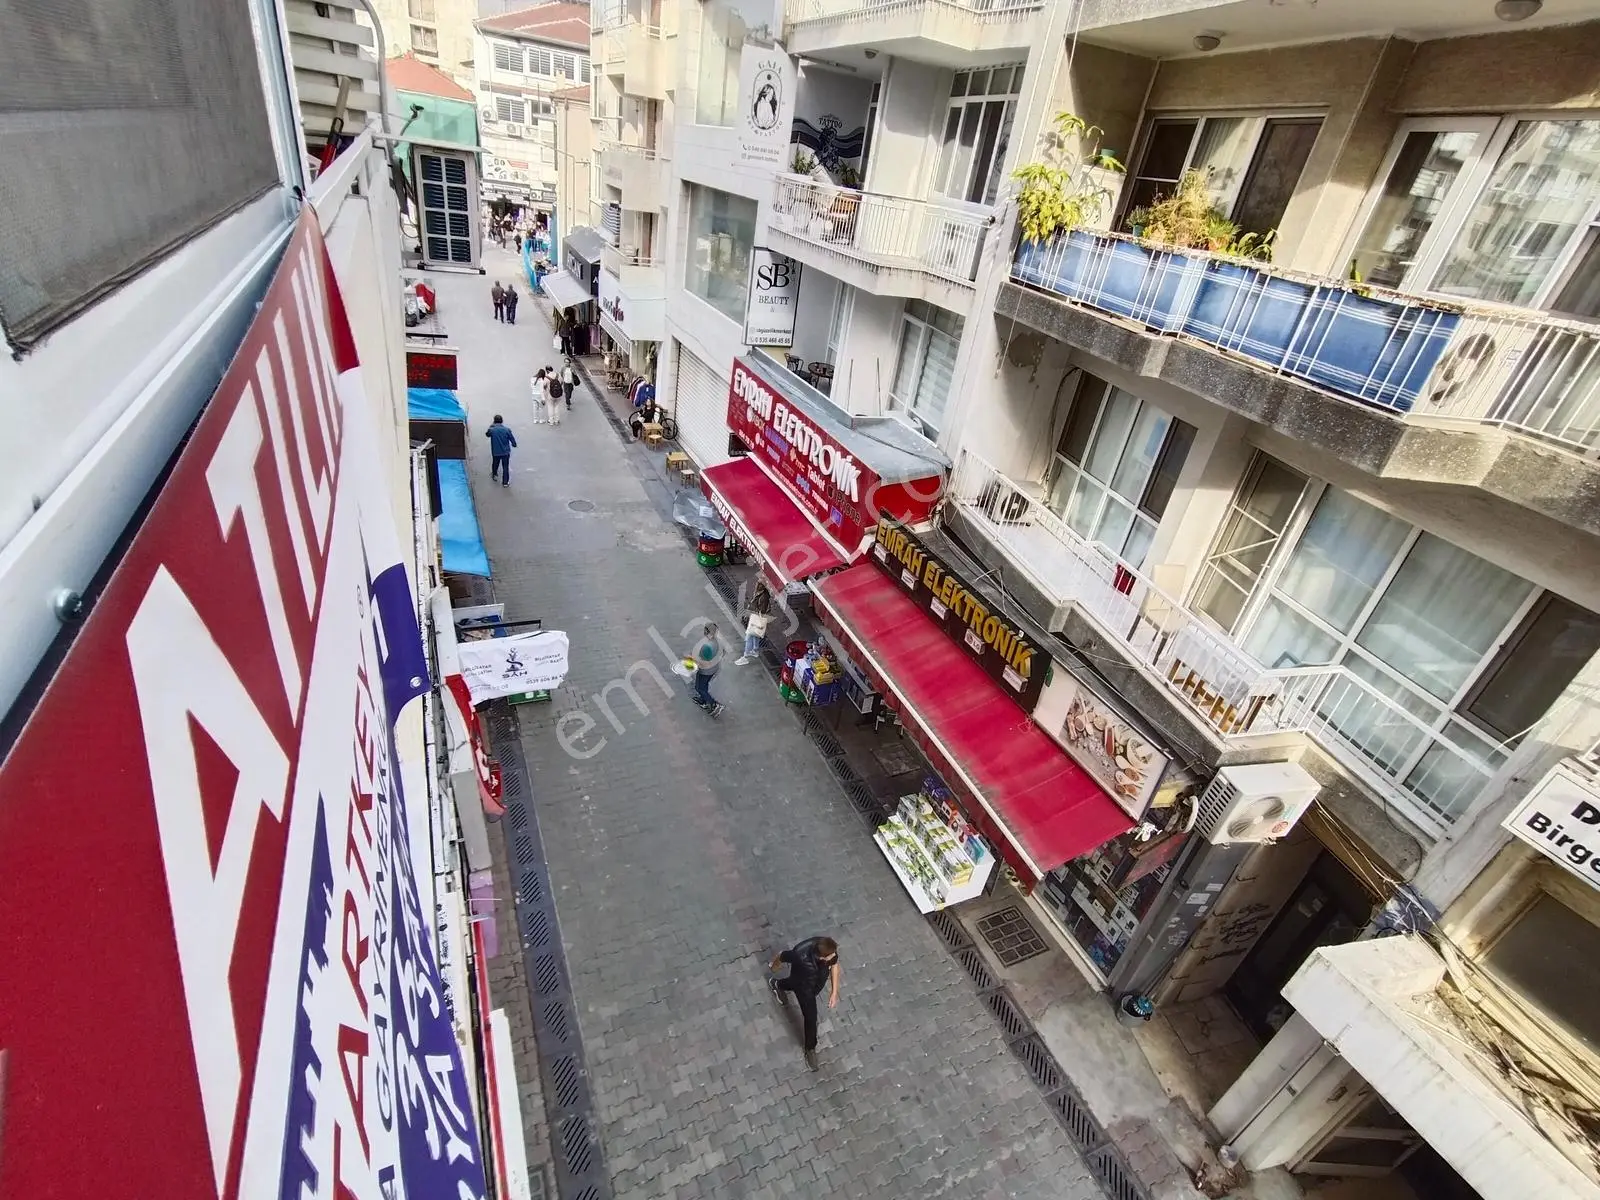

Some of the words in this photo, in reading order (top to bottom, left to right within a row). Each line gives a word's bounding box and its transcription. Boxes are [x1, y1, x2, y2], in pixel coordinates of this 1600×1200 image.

[756, 262, 790, 291] SB
[758, 295, 790, 306] BEAUTY
[733, 367, 774, 422] EMRAH
[806, 464, 826, 492] Tablet
[710, 491, 732, 523] EMRAH
[876, 519, 927, 578] EMRAH
[923, 560, 1035, 678] ELEKTRONİK
